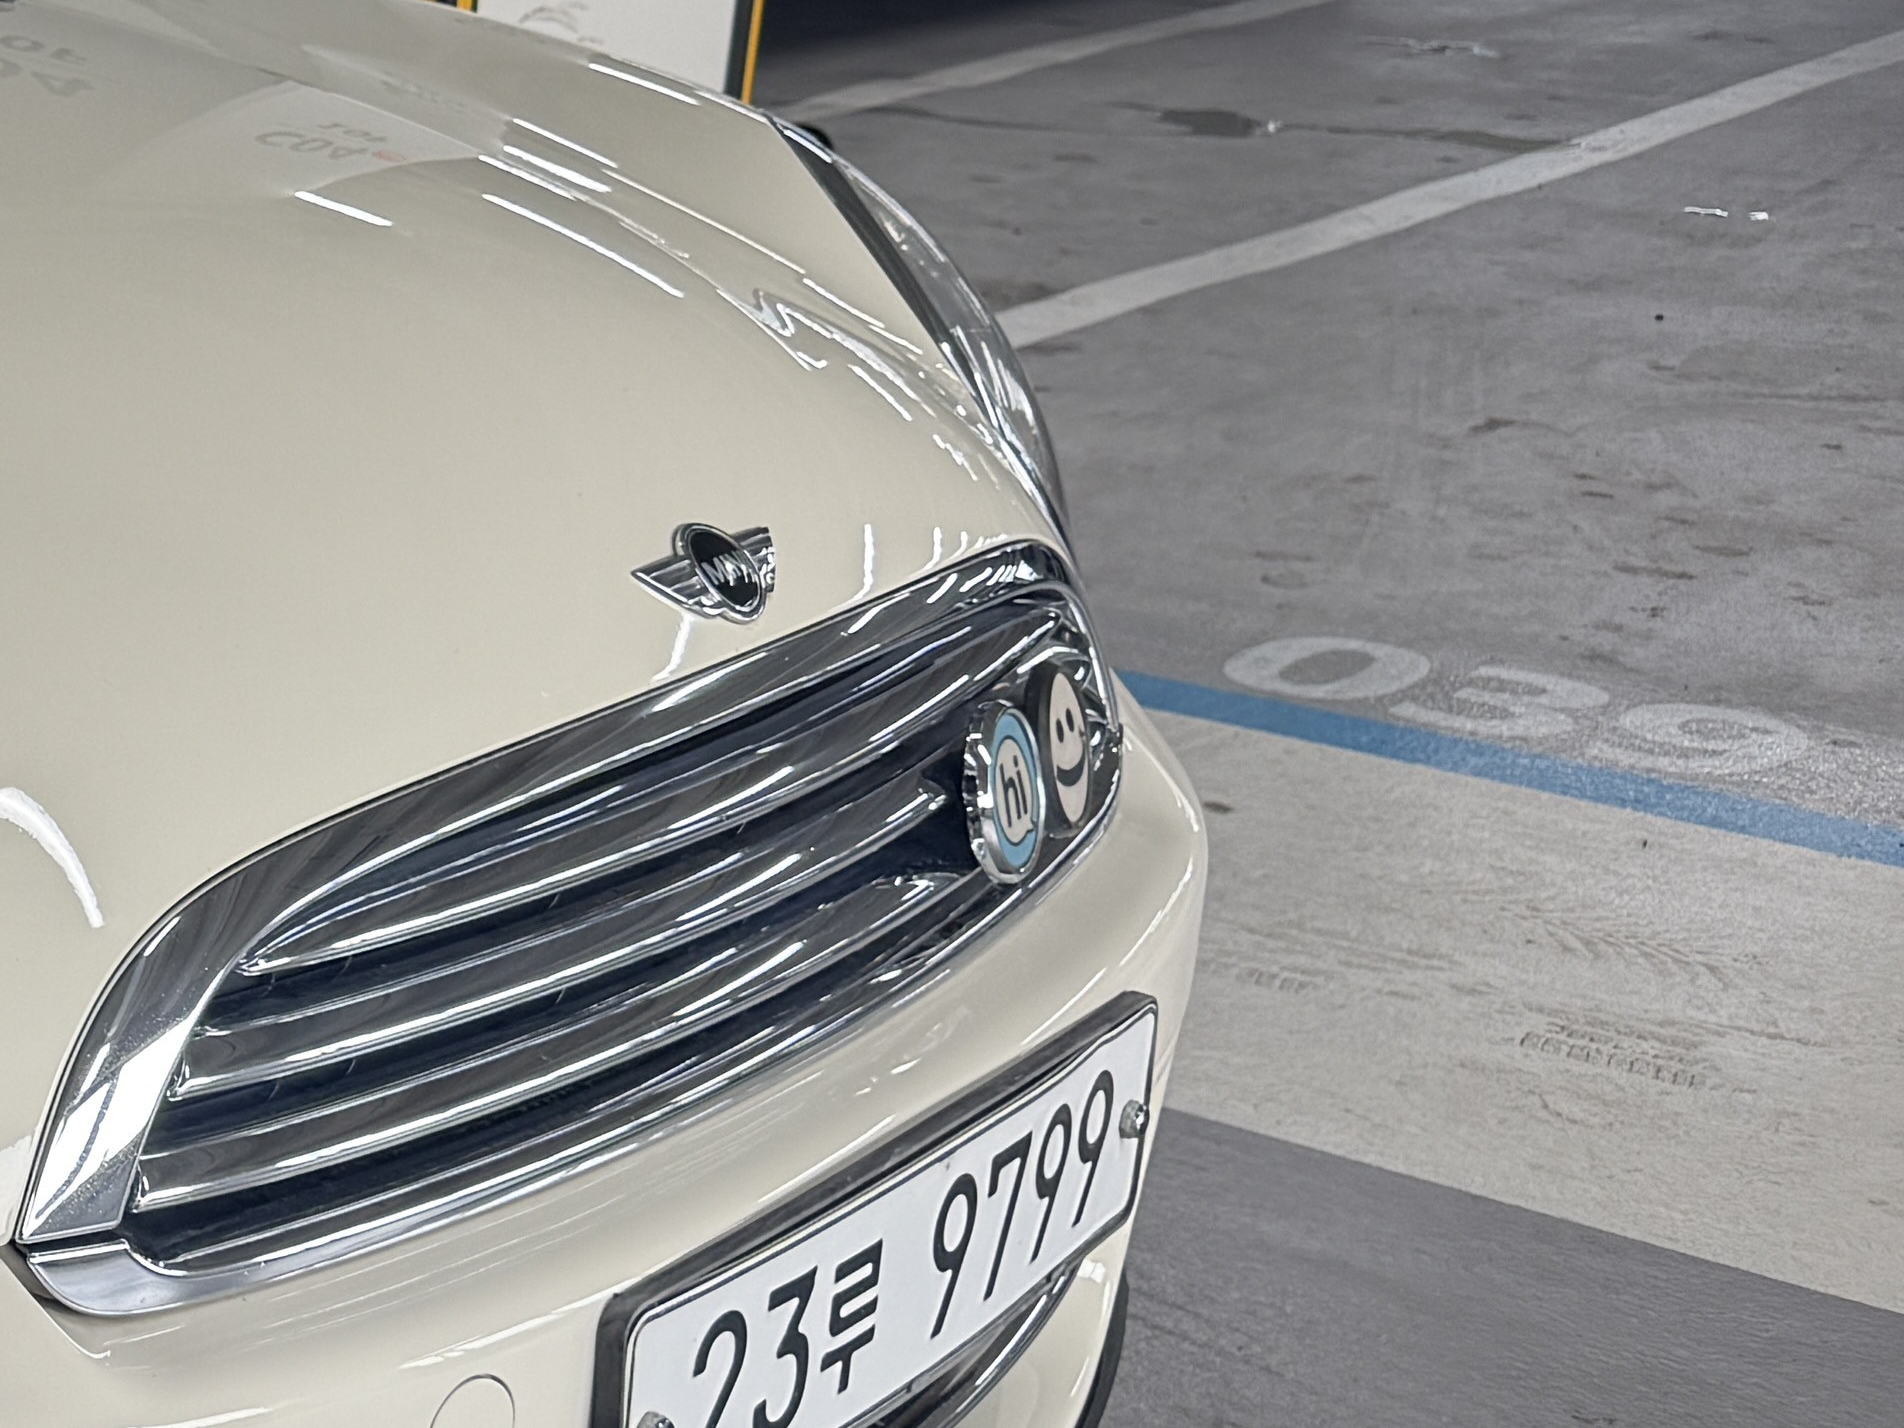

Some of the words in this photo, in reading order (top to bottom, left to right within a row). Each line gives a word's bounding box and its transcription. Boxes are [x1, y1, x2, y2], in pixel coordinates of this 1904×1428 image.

[1222, 635, 1810, 775] 039
[998, 754, 1029, 828] hi
[928, 1068, 1115, 1341] 9799
